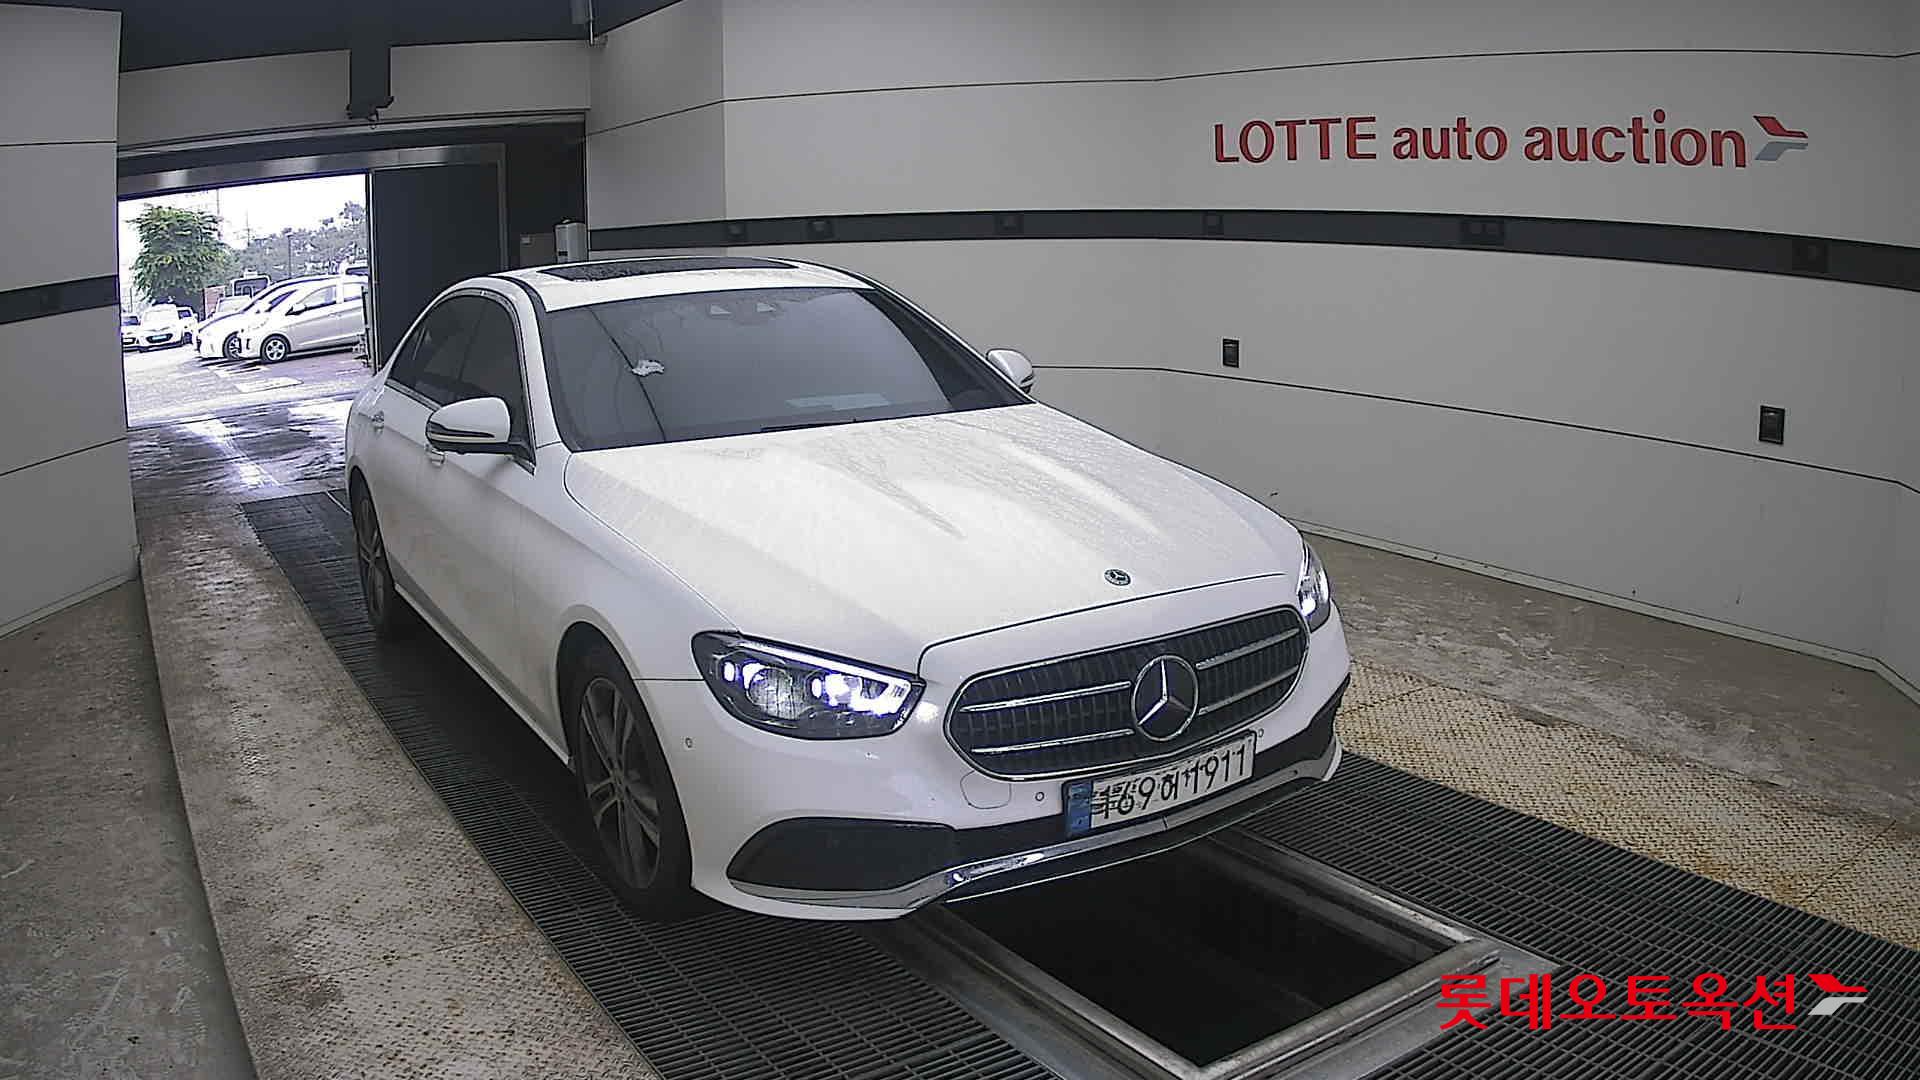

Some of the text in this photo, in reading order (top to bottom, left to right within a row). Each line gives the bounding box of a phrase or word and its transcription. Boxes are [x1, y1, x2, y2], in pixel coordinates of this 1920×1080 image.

[1214, 109, 1747, 168] LOTTE auto auction
